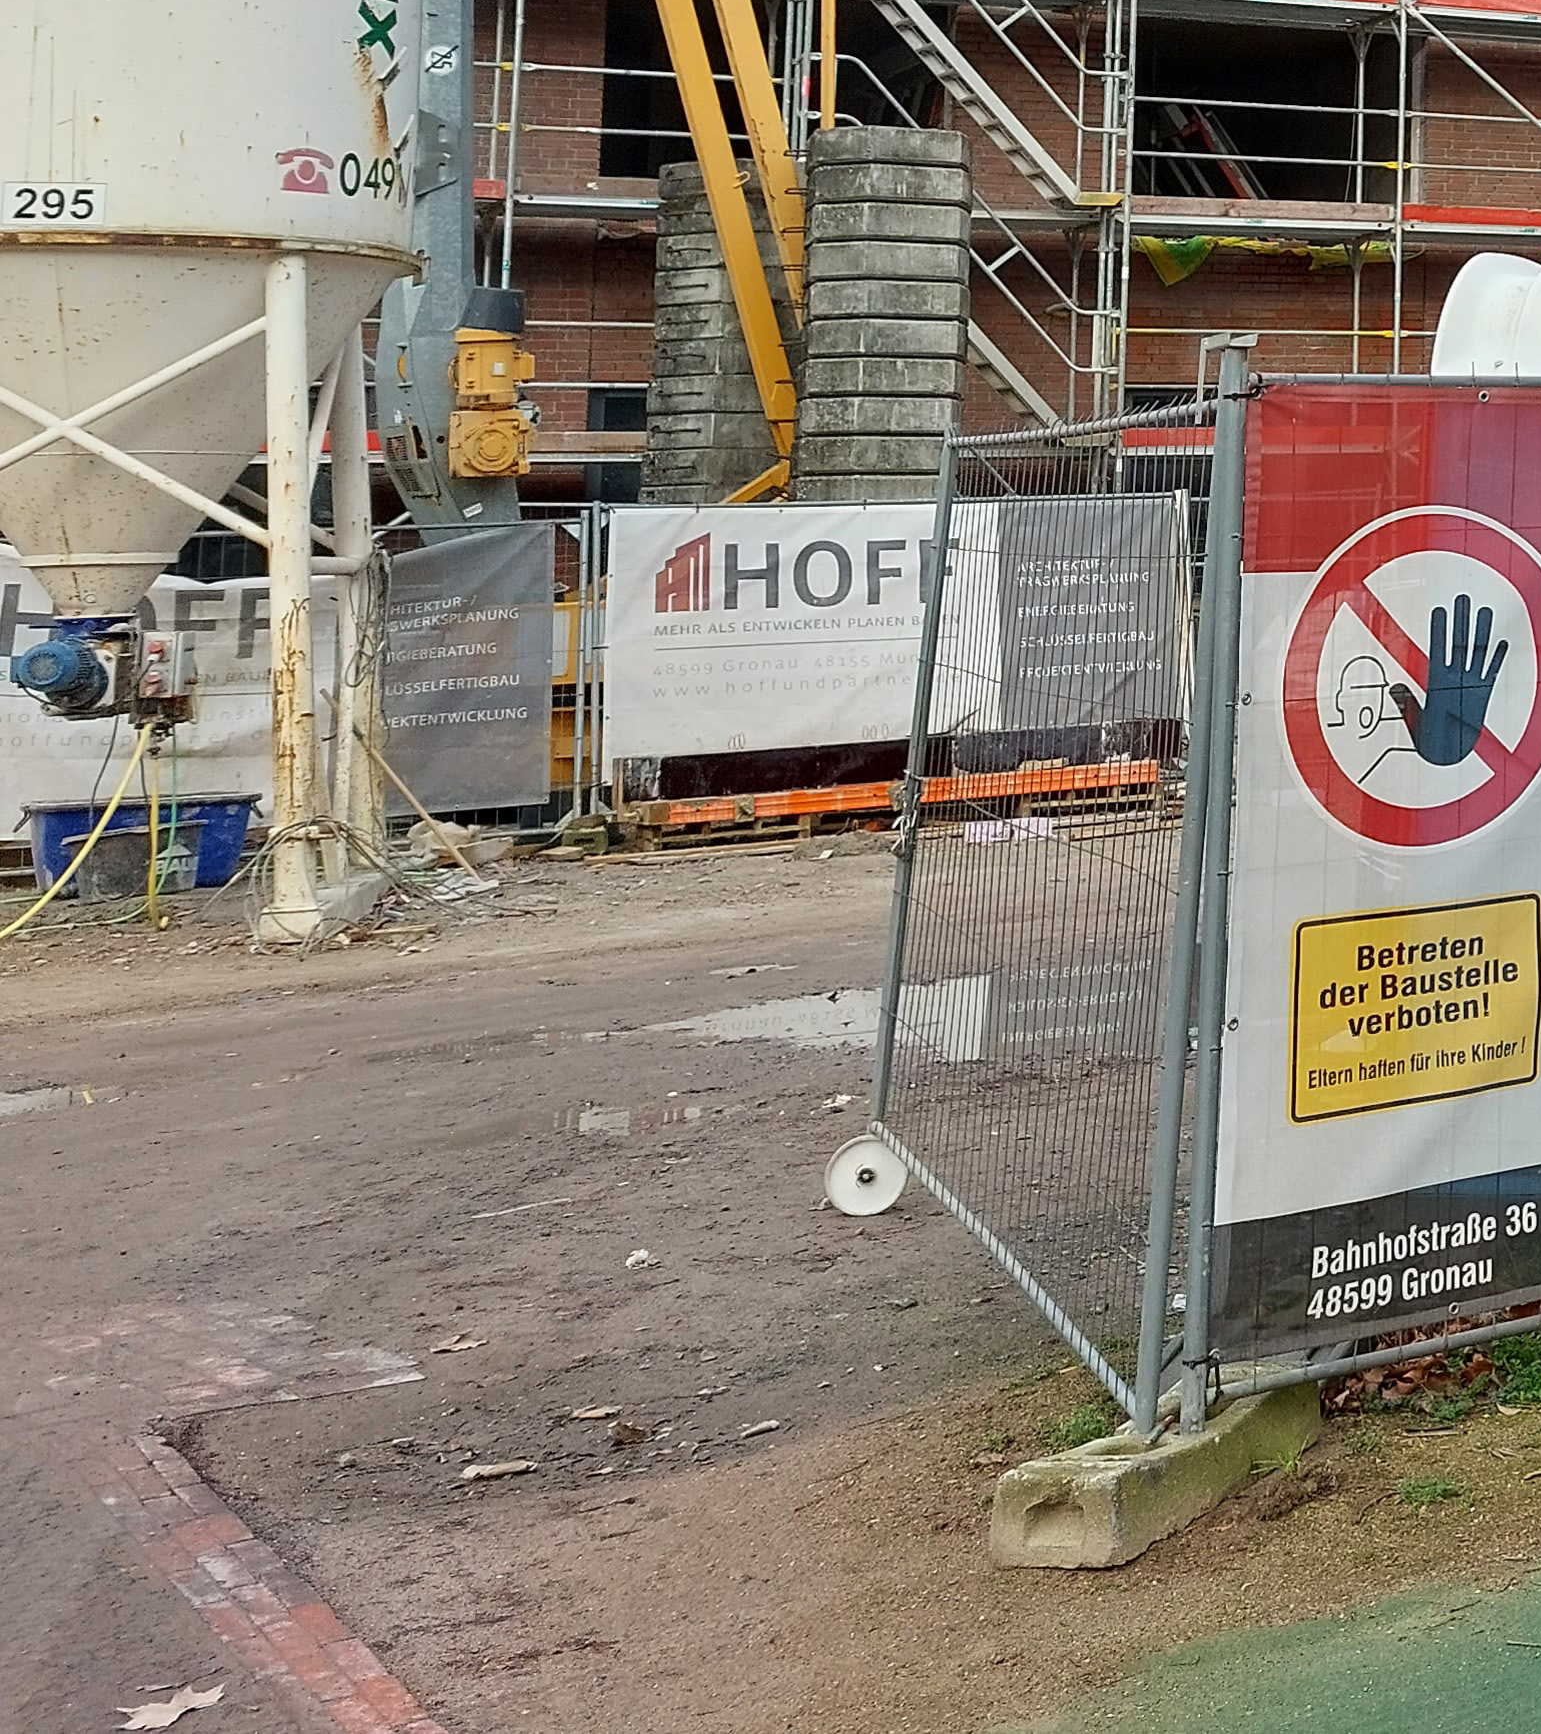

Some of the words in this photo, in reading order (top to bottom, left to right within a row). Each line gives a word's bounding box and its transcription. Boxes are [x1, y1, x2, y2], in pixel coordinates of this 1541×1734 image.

[12, 188, 94, 220] 295
[653, 623, 702, 636] MEHR
[708, 621, 735, 634] ALS
[743, 617, 841, 632] ENTWICKELN
[848, 615, 905, 628] PLANEN
[1357, 935, 1484, 971] Betreten
[1319, 981, 1369, 1009] der
[1380, 958, 1519, 1001] Baustelle
[1347, 991, 1490, 1038] verboten!
[1308, 1068, 1353, 1090] Eltern
[1358, 1058, 1405, 1082] haften
[1410, 1052, 1431, 1072] für
[1435, 1048, 1466, 1068] ihre
[1471, 1039, 1518, 1064] Kinder
[1311, 1212, 1497, 1279] Bahnhofstraße
[1505, 1201, 1538, 1237] 36
[1306, 1273, 1393, 1319] 48599
[1401, 1258, 1493, 1302] Gronau
